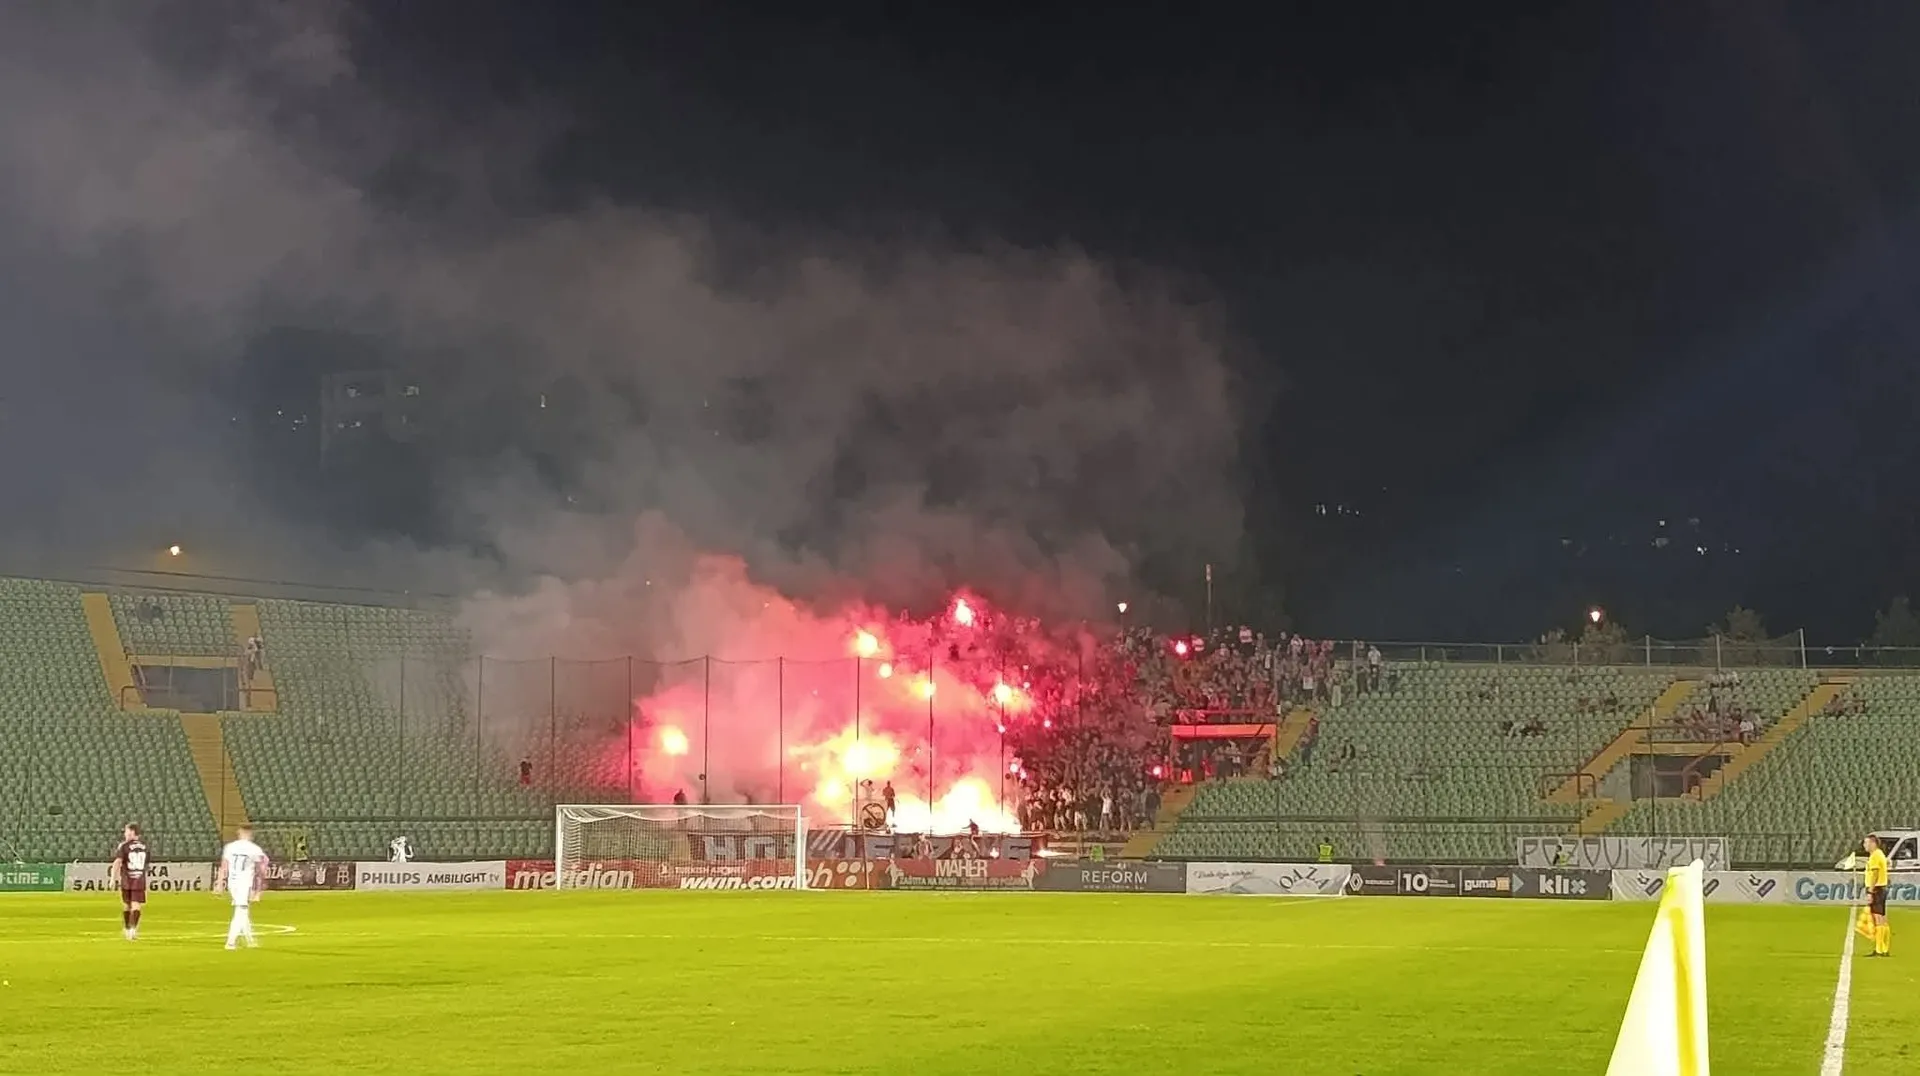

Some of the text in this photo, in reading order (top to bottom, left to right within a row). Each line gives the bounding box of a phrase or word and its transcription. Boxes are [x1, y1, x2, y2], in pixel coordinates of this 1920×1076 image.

[232, 853, 248, 871] 77
[936, 859, 987, 878] MAHER
[361, 872, 420, 884] PHILIPS
[426, 872, 486, 884] AMBILIGHT
[680, 874, 797, 890] wwin.com
[1081, 870, 1148, 884] REFORM
[1403, 873, 1428, 892] 10
[1539, 874, 1587, 895] klix
